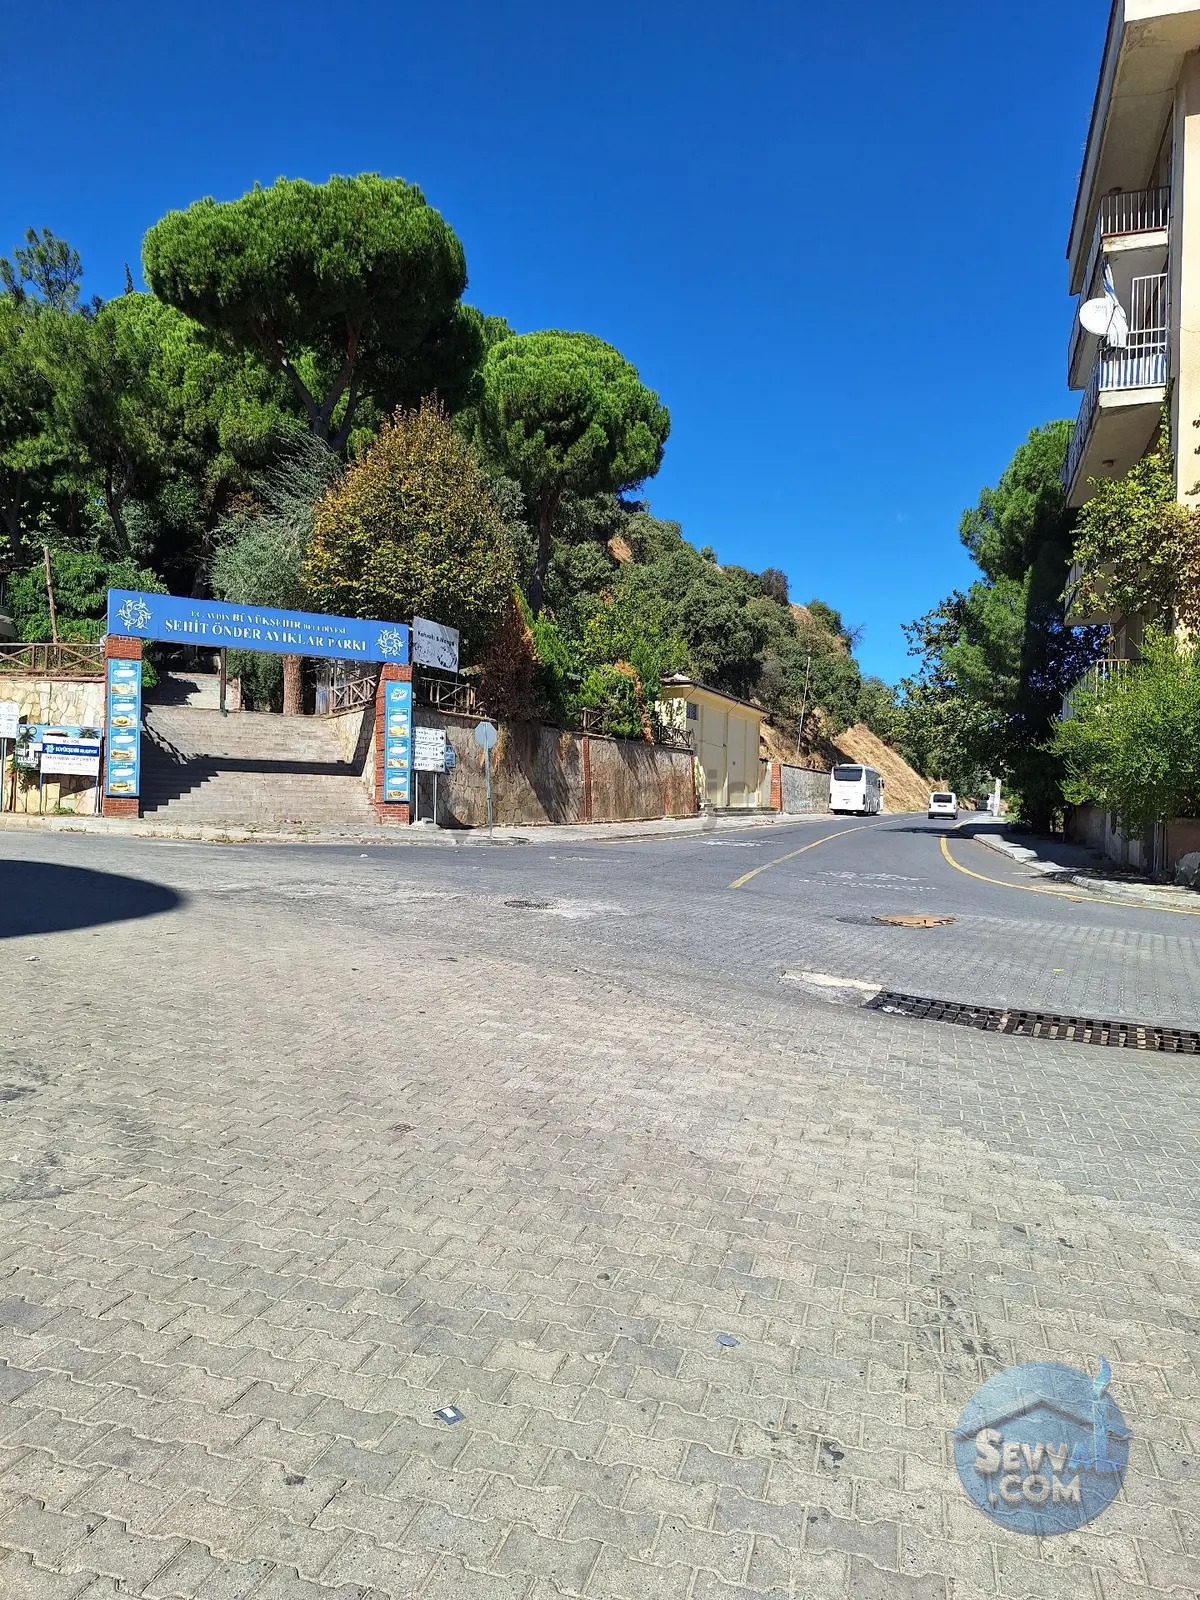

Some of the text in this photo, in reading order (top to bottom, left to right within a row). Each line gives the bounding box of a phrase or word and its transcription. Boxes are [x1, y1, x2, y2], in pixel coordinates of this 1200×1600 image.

[232, 611, 301, 629] BÜYÜKŞEHİR
[165, 619, 367, 651] ŞEHİT ÖNDER AYIKLAR PARKI
